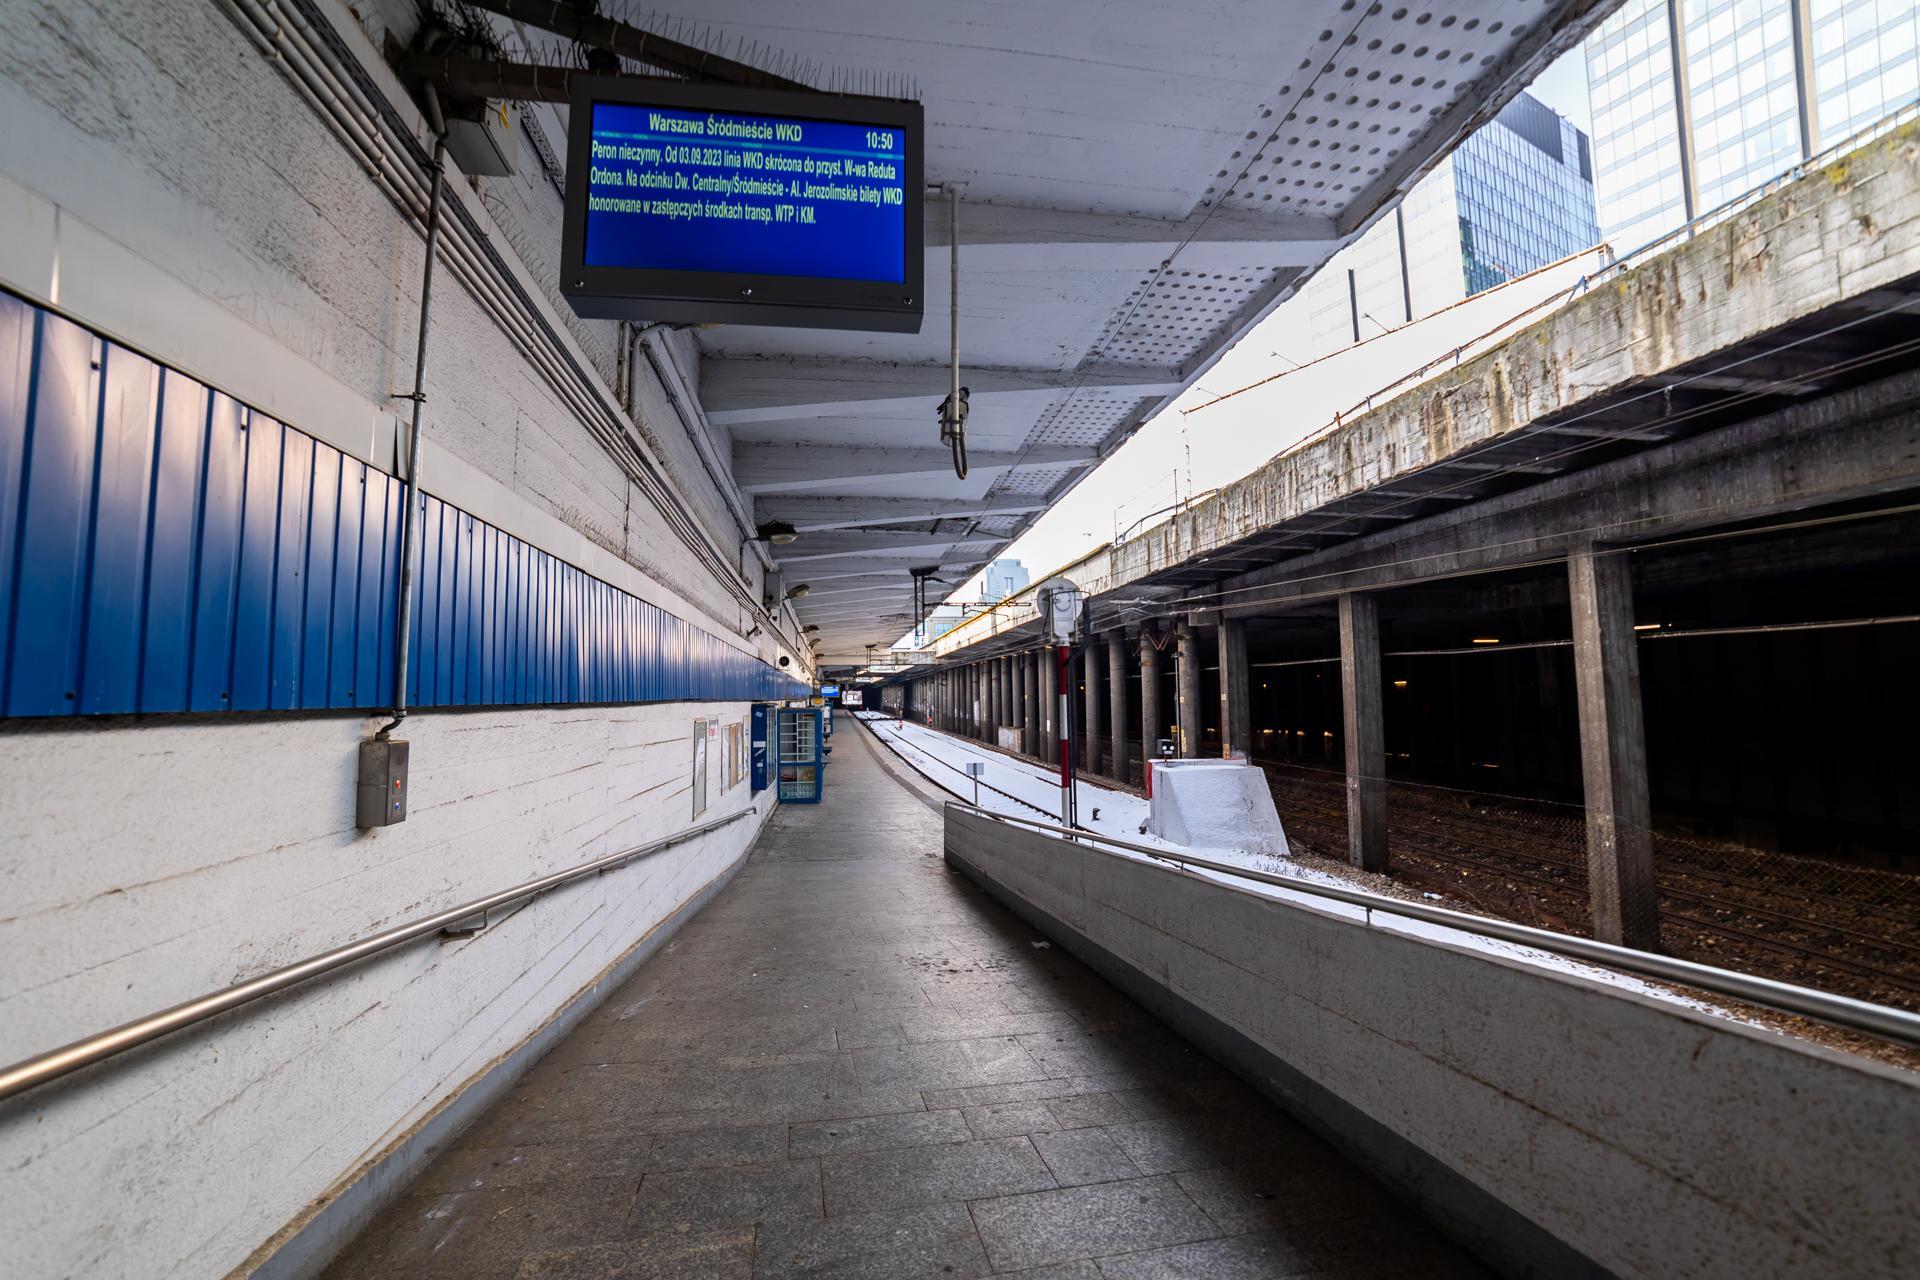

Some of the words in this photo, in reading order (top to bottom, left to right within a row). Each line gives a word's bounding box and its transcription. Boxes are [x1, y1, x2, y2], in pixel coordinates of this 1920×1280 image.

[649, 112, 703, 135] Warszawa
[707, 113, 773, 140] Śródmieście
[775, 123, 803, 142] WKD
[865, 131, 894, 150] 10:50
[591, 140, 617, 159] Peron
[618, 142, 663, 165] nieczynny.
[664, 145, 678, 163] Od
[679, 146, 722, 167] 03.09.2023
[724, 149, 741, 167] linia
[743, 152, 764, 170] WKD
[765, 152, 802, 173] skrócona
[803, 155, 815, 174] do
[816, 159, 843, 180] przyst.
[845, 159, 867, 178] W-wa
[867, 160, 896, 180] Reduta
[590, 165, 623, 187] Ordona.
[625, 168, 638, 187] Na
[639, 168, 673, 190] odcinku
[674, 172, 691, 190] Dw.
[692, 172, 783, 197] Centralny/Śródmieście
[803, 180, 859, 203] Jerozolimskie
[859, 183, 882, 208] bilety
[882, 186, 903, 206] WKD
[588, 192, 641, 214] honorowane
[642, 199, 651, 214] w
[652, 198, 703, 221] zastępczych
[704, 198, 743, 220] środkach
[744, 202, 773, 225] transp.
[775, 204, 795, 223] WTP
[796, 205, 799, 223] i
[800, 205, 817, 225] KM.
